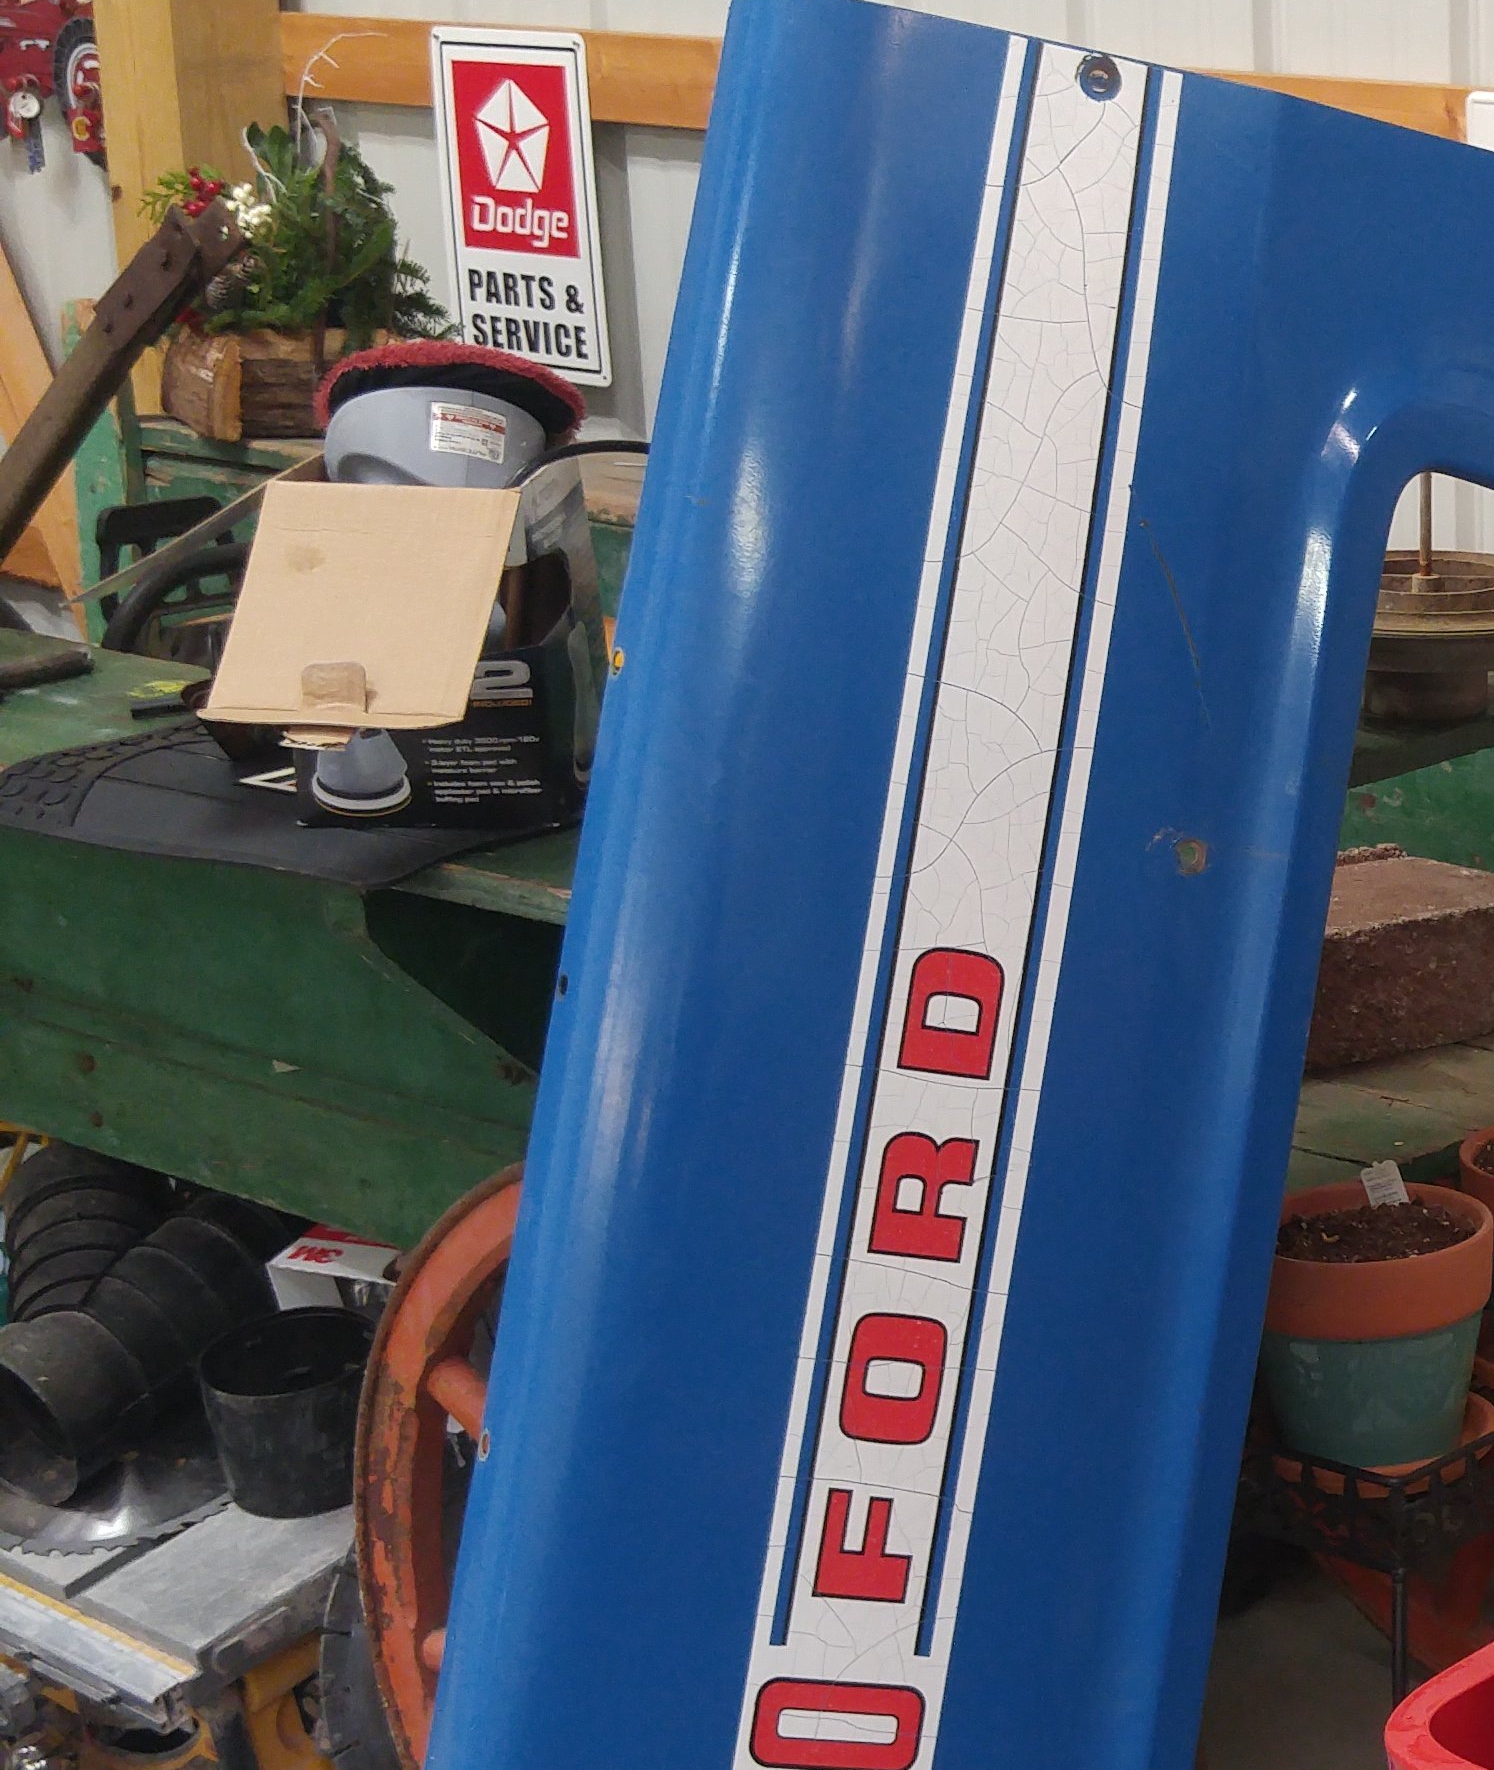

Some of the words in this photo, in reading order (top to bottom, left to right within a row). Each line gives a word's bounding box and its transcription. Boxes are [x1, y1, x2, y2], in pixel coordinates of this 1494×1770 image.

[471, 194, 570, 248] Dodge
[468, 267, 556, 311] PARTS
[565, 284, 586, 315] &
[472, 312, 590, 361] SERVICE
[811, 946, 1006, 1605] FORD
